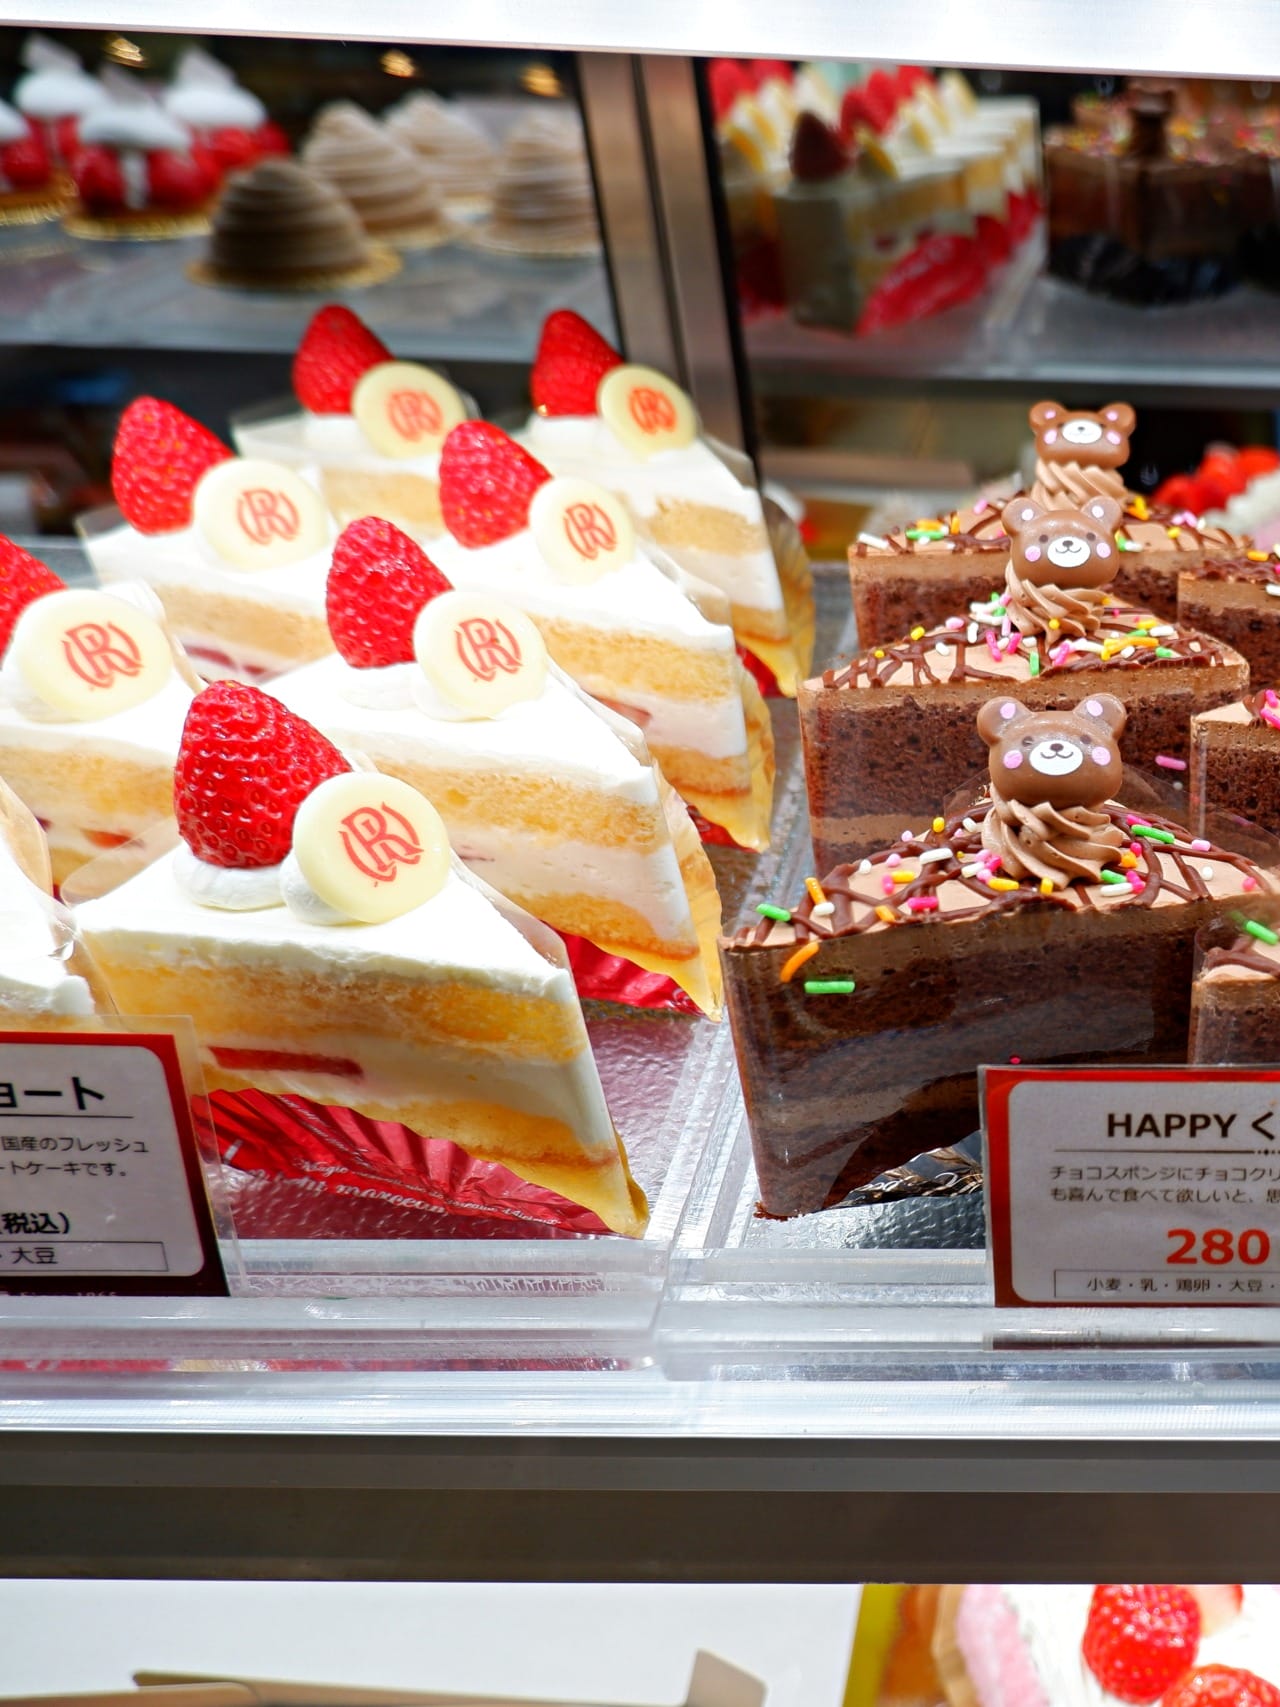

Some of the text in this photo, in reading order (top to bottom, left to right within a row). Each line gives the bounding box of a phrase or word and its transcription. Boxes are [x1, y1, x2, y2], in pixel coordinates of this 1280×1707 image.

[1107, 1113, 1236, 1138] HAPPY
[0, 1211, 70, 1234] 税込)
[1166, 1228, 1271, 1266] 280
